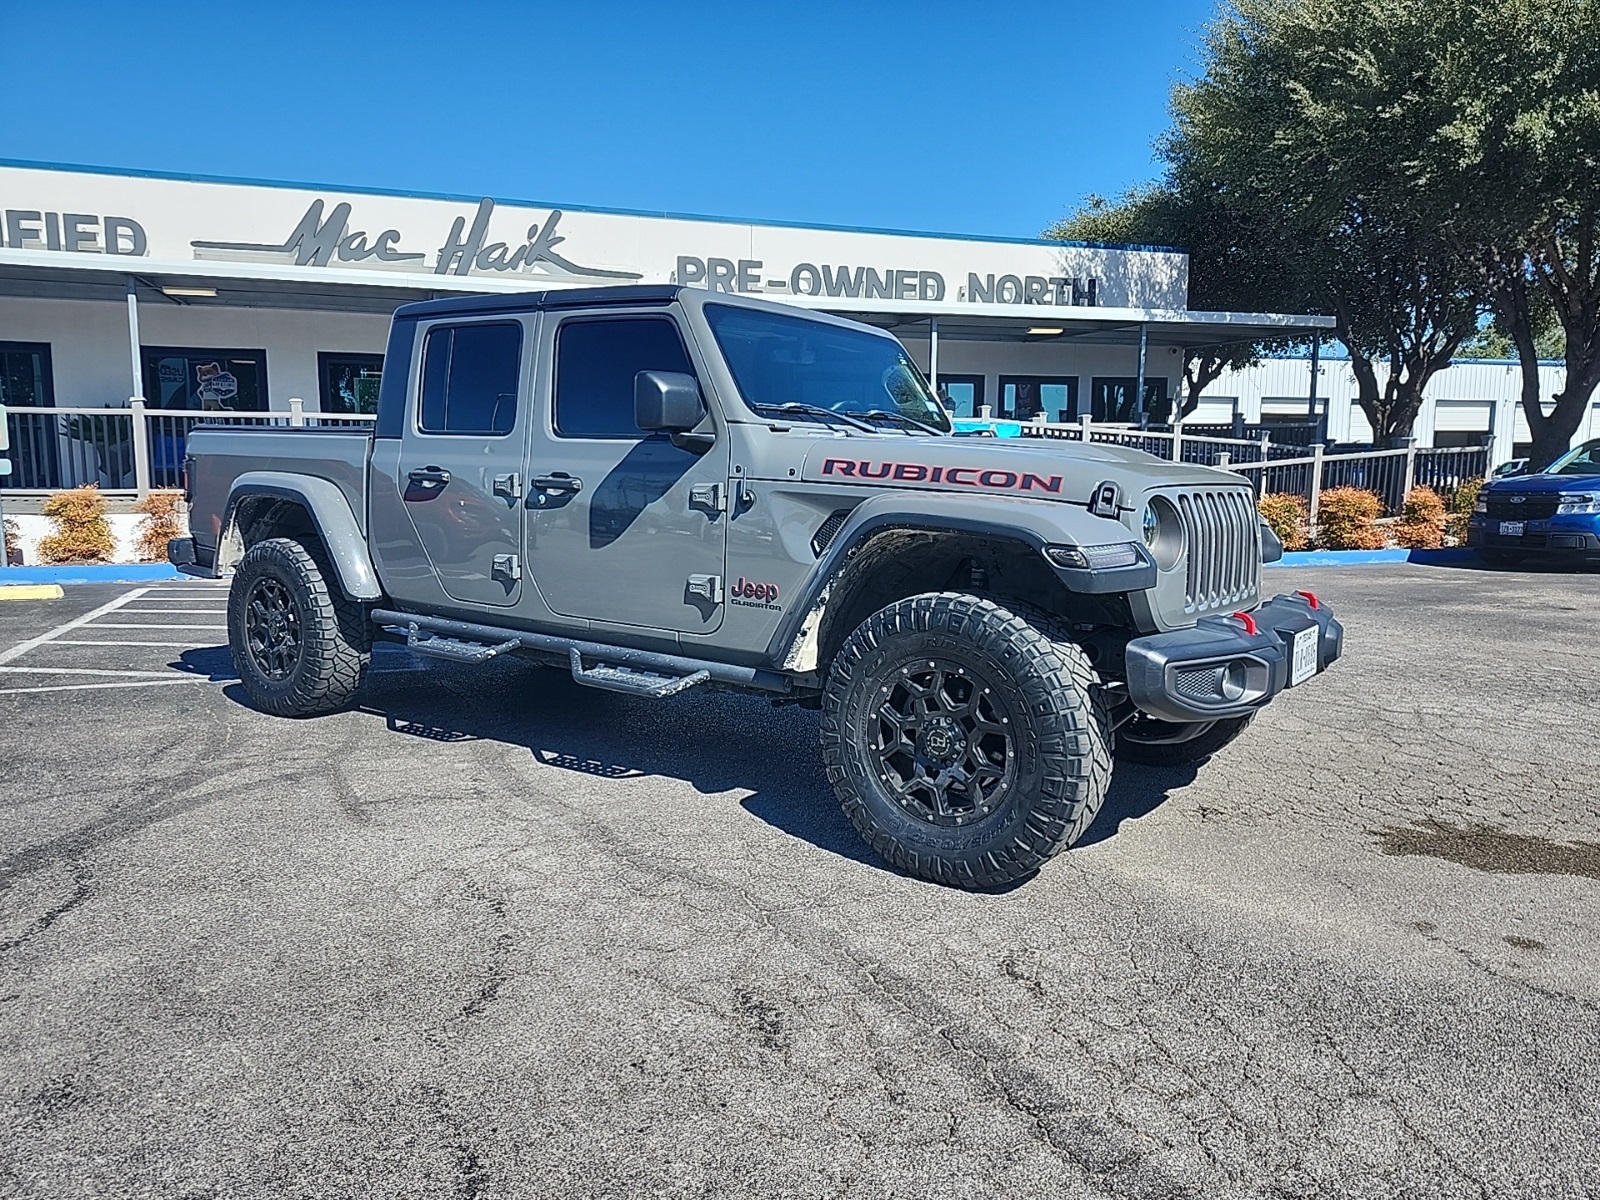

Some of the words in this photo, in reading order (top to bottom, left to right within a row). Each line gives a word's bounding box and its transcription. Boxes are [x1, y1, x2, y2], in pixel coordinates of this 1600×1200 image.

[0, 209, 147, 257] FIED
[191, 198, 424, 268] Mac
[434, 196, 644, 280] Haik
[677, 255, 946, 302] PRE-OWNED
[968, 272, 1097, 307] NORTH
[821, 457, 1065, 494] RUBICON
[730, 598, 782, 611] GLADIATOR
[731, 576, 780, 604] Jeep
